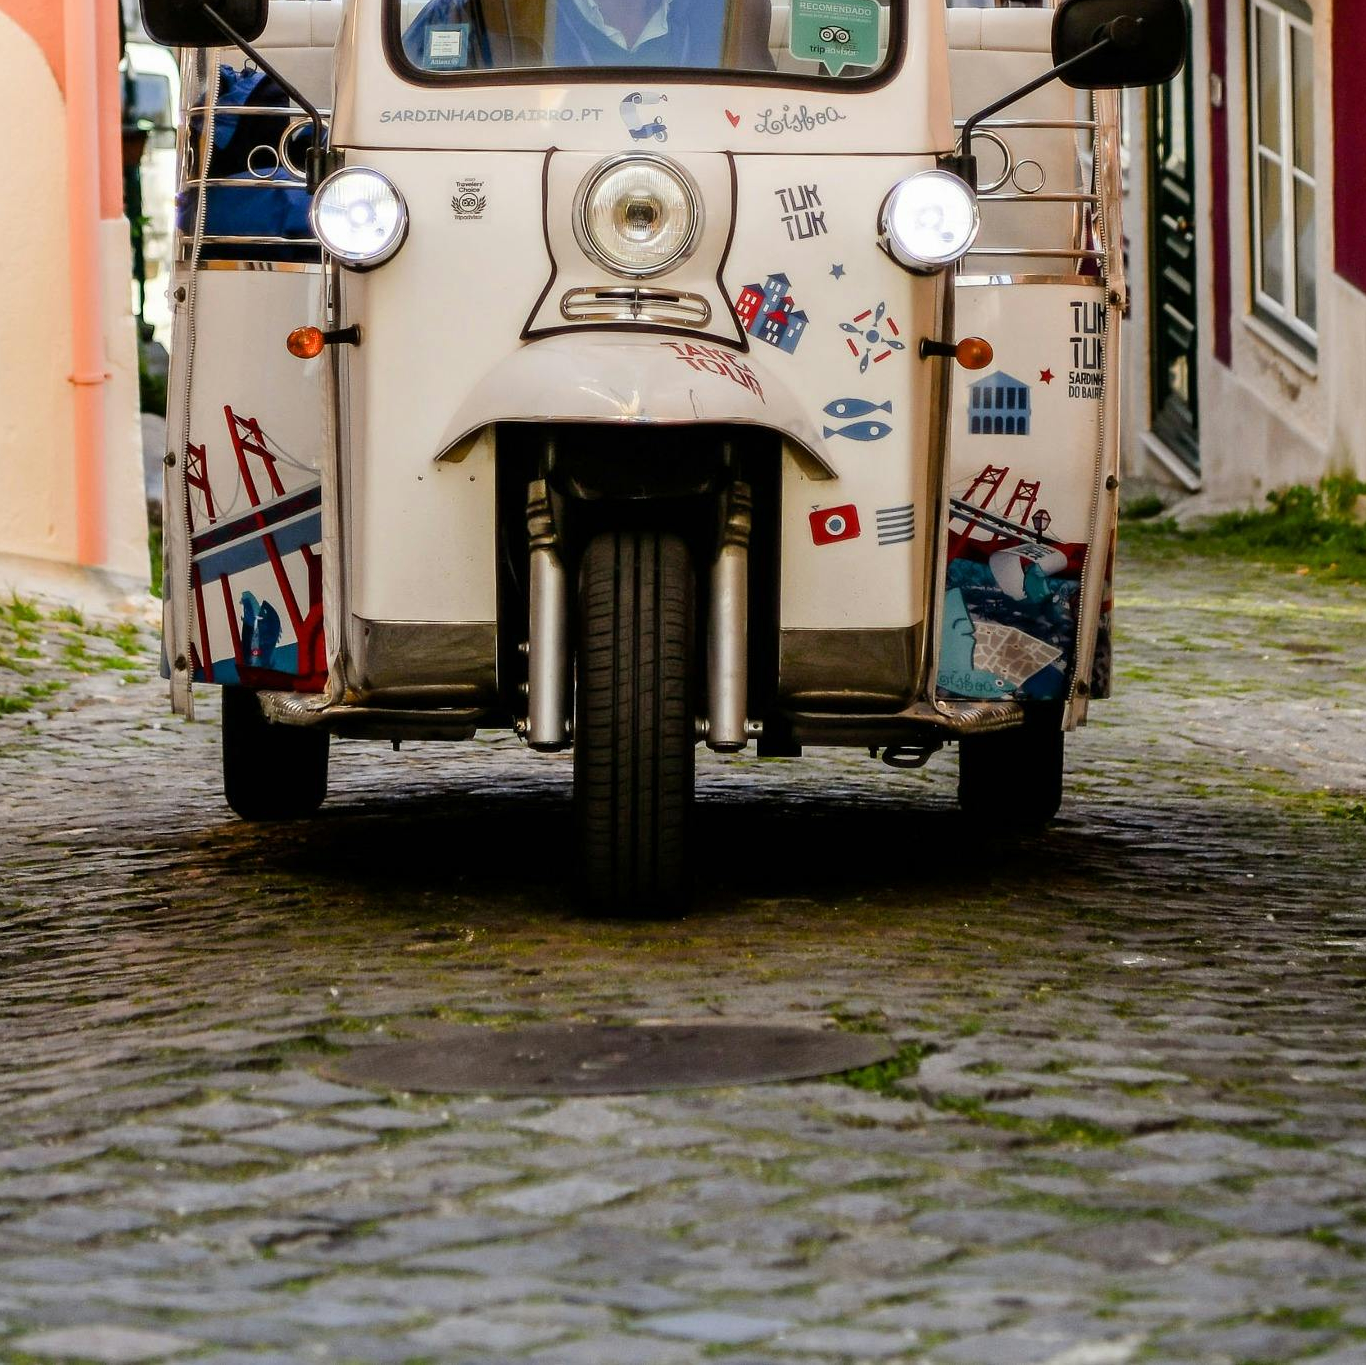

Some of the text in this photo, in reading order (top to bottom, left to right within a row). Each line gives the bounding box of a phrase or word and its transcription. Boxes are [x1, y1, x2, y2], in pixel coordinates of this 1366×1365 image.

[799, 2, 872, 17] RECOMENDADO
[809, 43, 861, 57] tripadvisor
[378, 108, 604, 125] SARDINHADOBAIRRO.PT
[753, 104, 847, 137] Lisboa
[774, 183, 823, 214] TUK
[780, 210, 829, 241] TUK
[659, 341, 743, 371] TAKE
[675, 356, 767, 405] TOUR
[1068, 385, 1080, 398] DO
